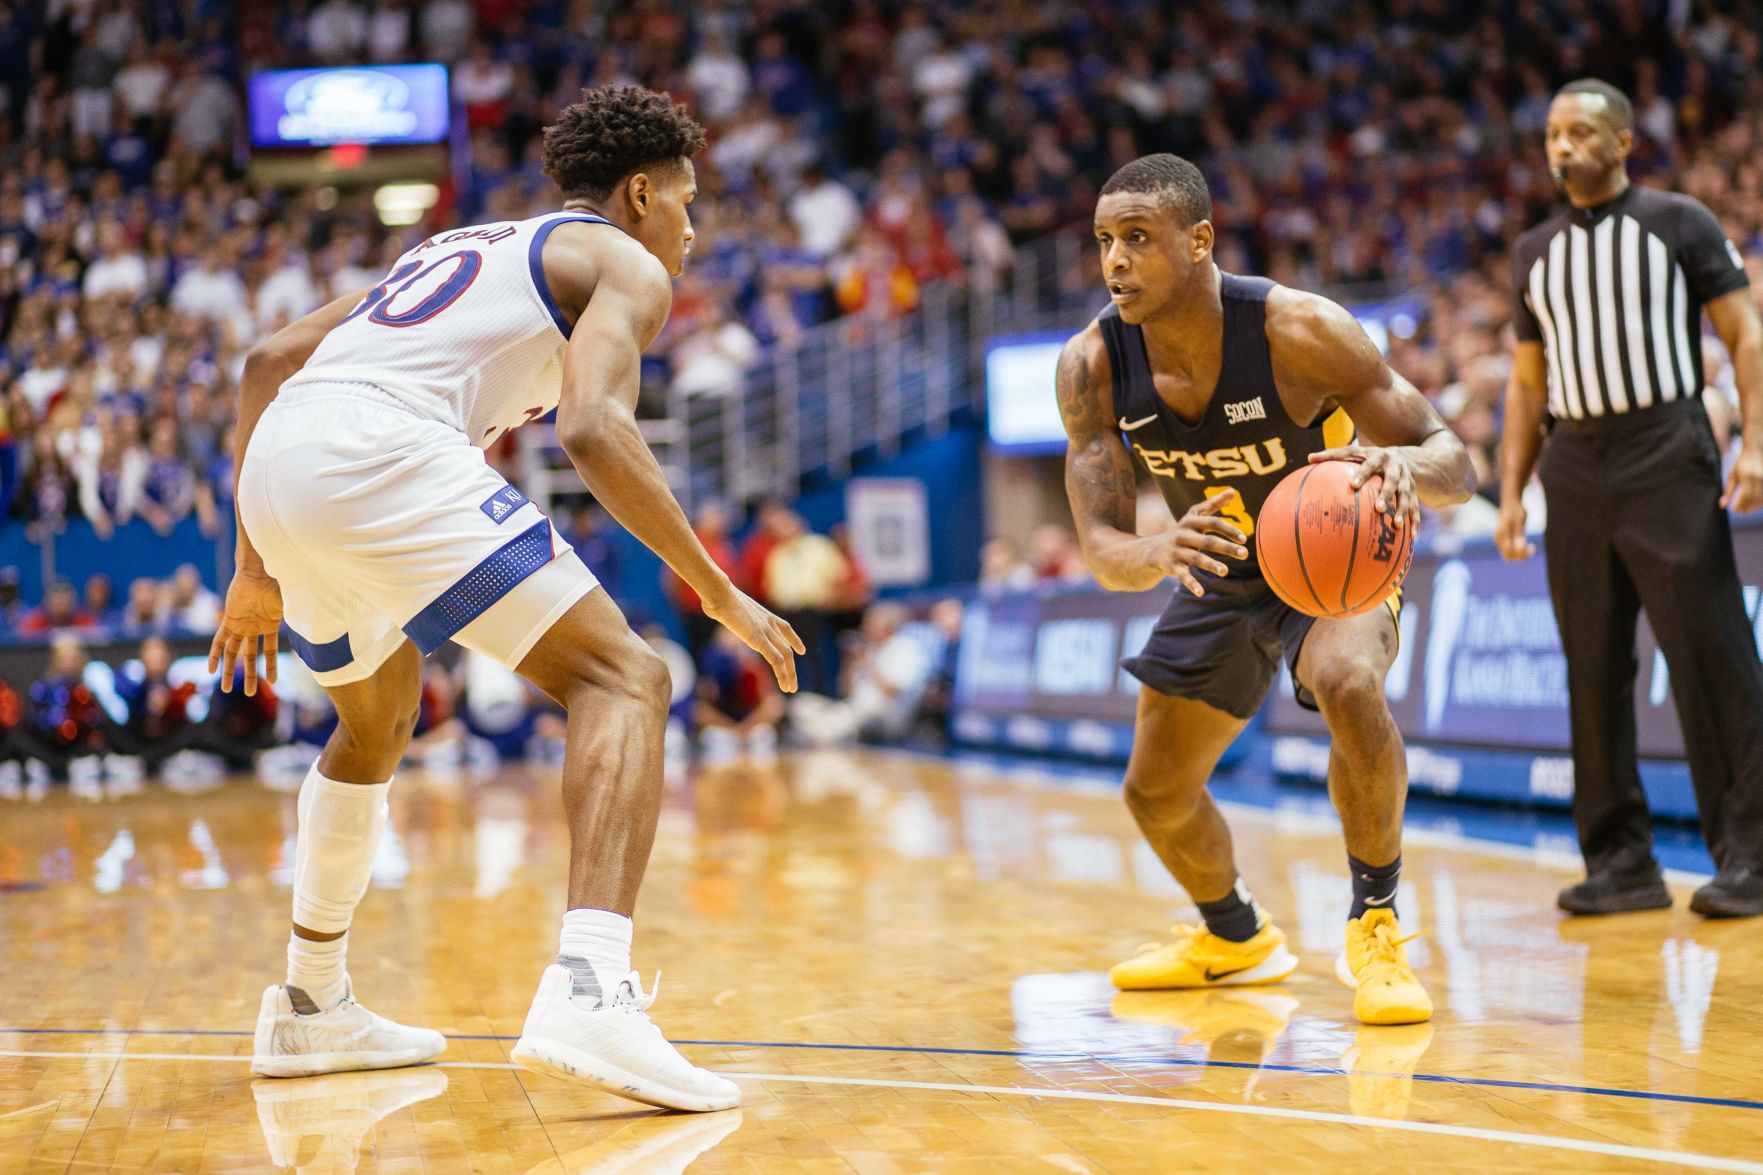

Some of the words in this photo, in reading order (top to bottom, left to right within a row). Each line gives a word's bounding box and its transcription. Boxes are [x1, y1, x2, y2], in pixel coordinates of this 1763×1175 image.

[1223, 396, 1266, 425] SOCON
[1132, 436, 1287, 480] ETSU
[504, 488, 522, 503] KU
[1373, 504, 1396, 563] CAA
